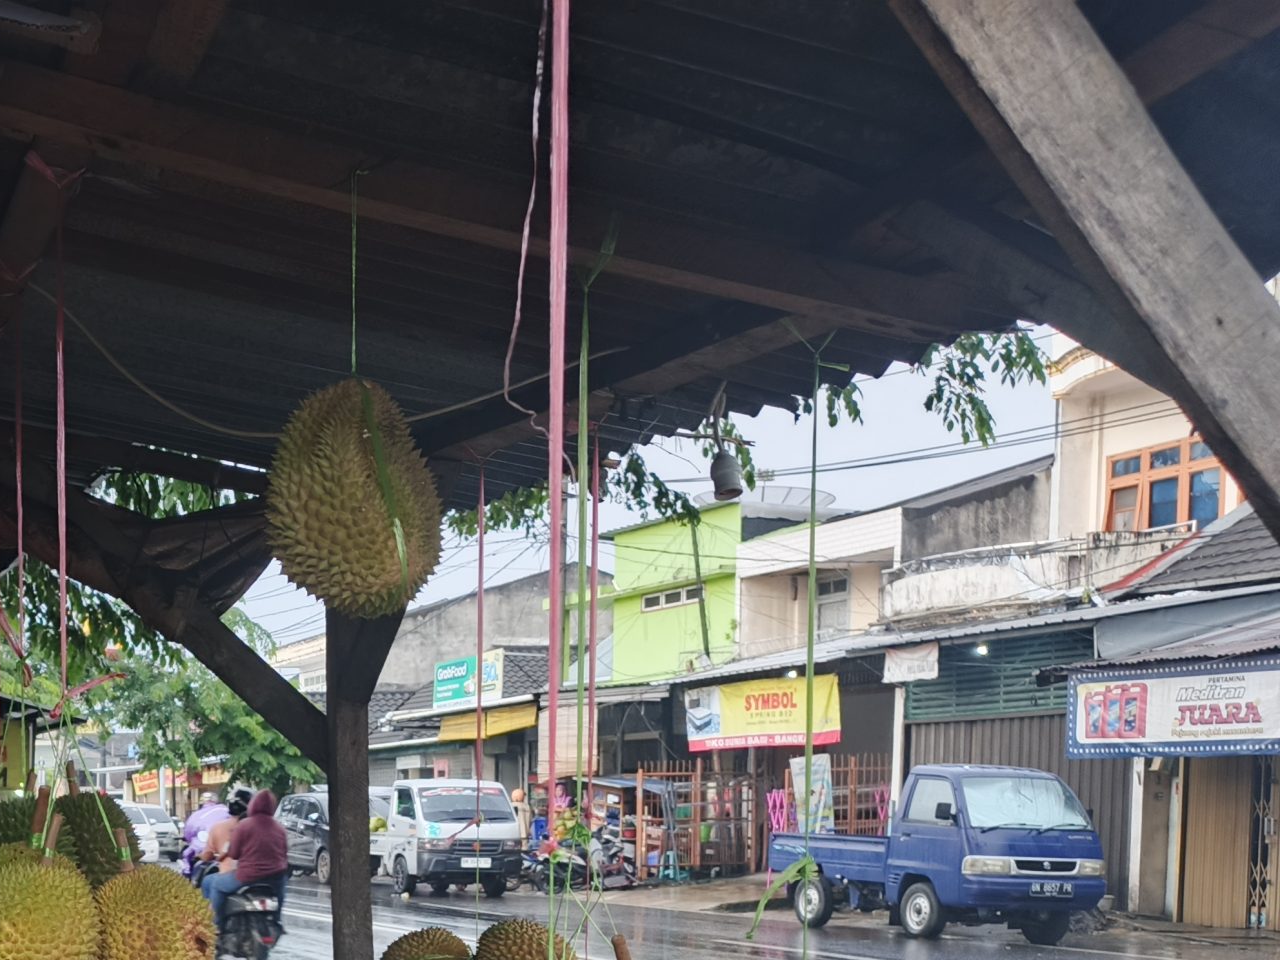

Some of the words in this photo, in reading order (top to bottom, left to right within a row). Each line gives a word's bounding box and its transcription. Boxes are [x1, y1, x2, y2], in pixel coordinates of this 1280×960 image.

[437, 662, 467, 681] GrabFood
[744, 691, 797, 711] SYMBOL
[1176, 685, 1246, 702] Meditran
[1174, 701, 1262, 726] JUARA
